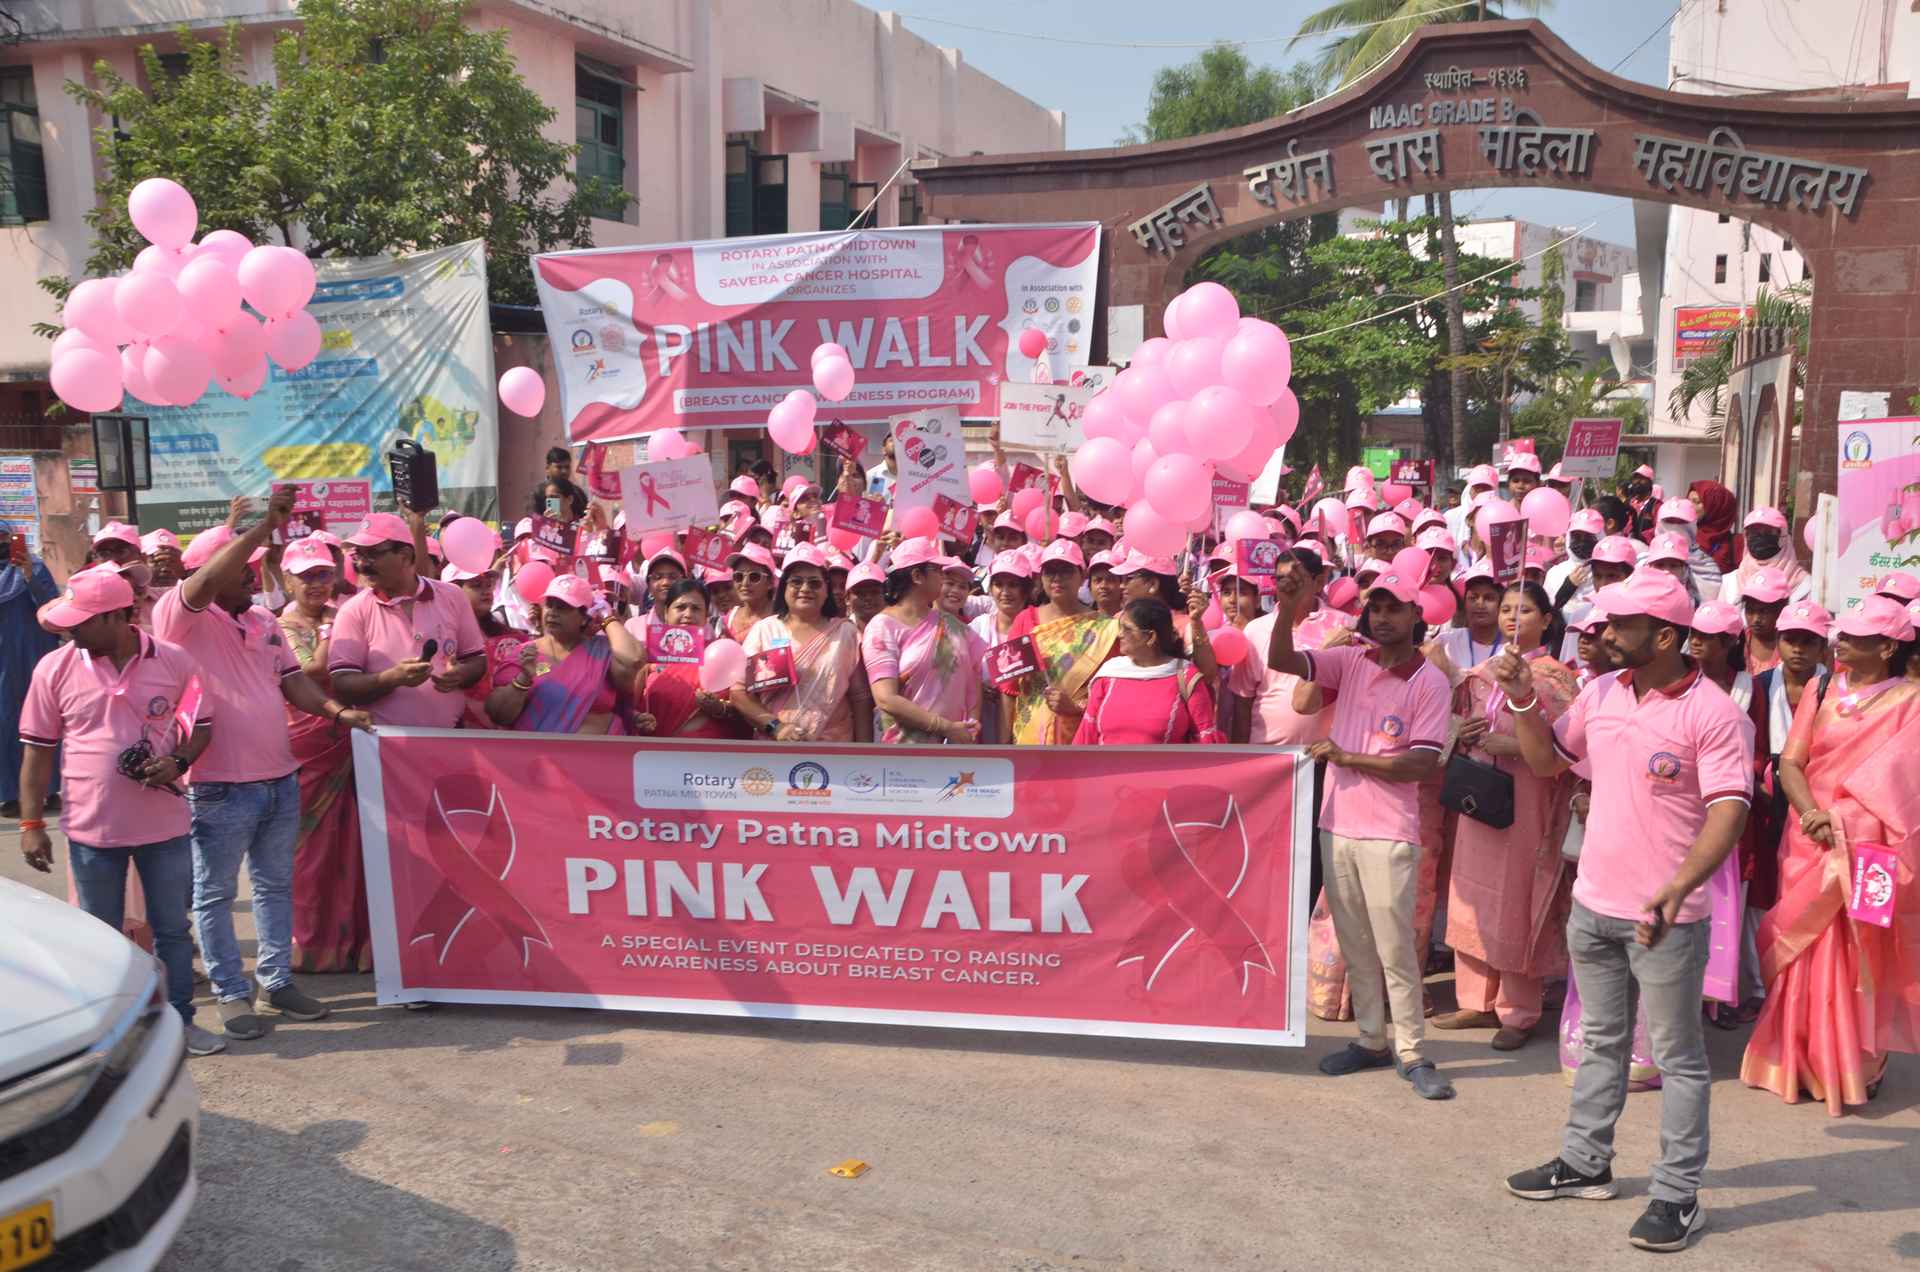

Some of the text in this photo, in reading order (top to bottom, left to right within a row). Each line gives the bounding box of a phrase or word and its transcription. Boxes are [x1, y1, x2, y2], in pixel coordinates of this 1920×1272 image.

[1370, 103, 1424, 129] NAAC
[1428, 98, 1496, 125] GRADE
[1127, 105, 1868, 262] महन्त दर्शन दास महिला महाविद्यालय
[720, 239, 915, 263] ROTARY PATNA MIDTOWN
[752, 255, 888, 271] IN ASSOCIATION WITH
[719, 268, 922, 289] SAVERA CANCER HOSPITAL
[785, 284, 857, 296] ORGANIZES
[653, 314, 993, 378] PINK WALK
[897, 387, 976, 400] PROGRAM)
[644, 788, 678, 799] PATNA
[704, 789, 737, 800] TOWN
[683, 773, 737, 789] Rotary
[588, 815, 1067, 853] Rotary Patna Midtown
[565, 857, 1093, 934] PINK WALK
[600, 934, 1061, 967] A SPECIAL EVENT DEDICATED TO RAISING
[622, 953, 1041, 986] AWARENESS ABOUT BREAST CANCER.
